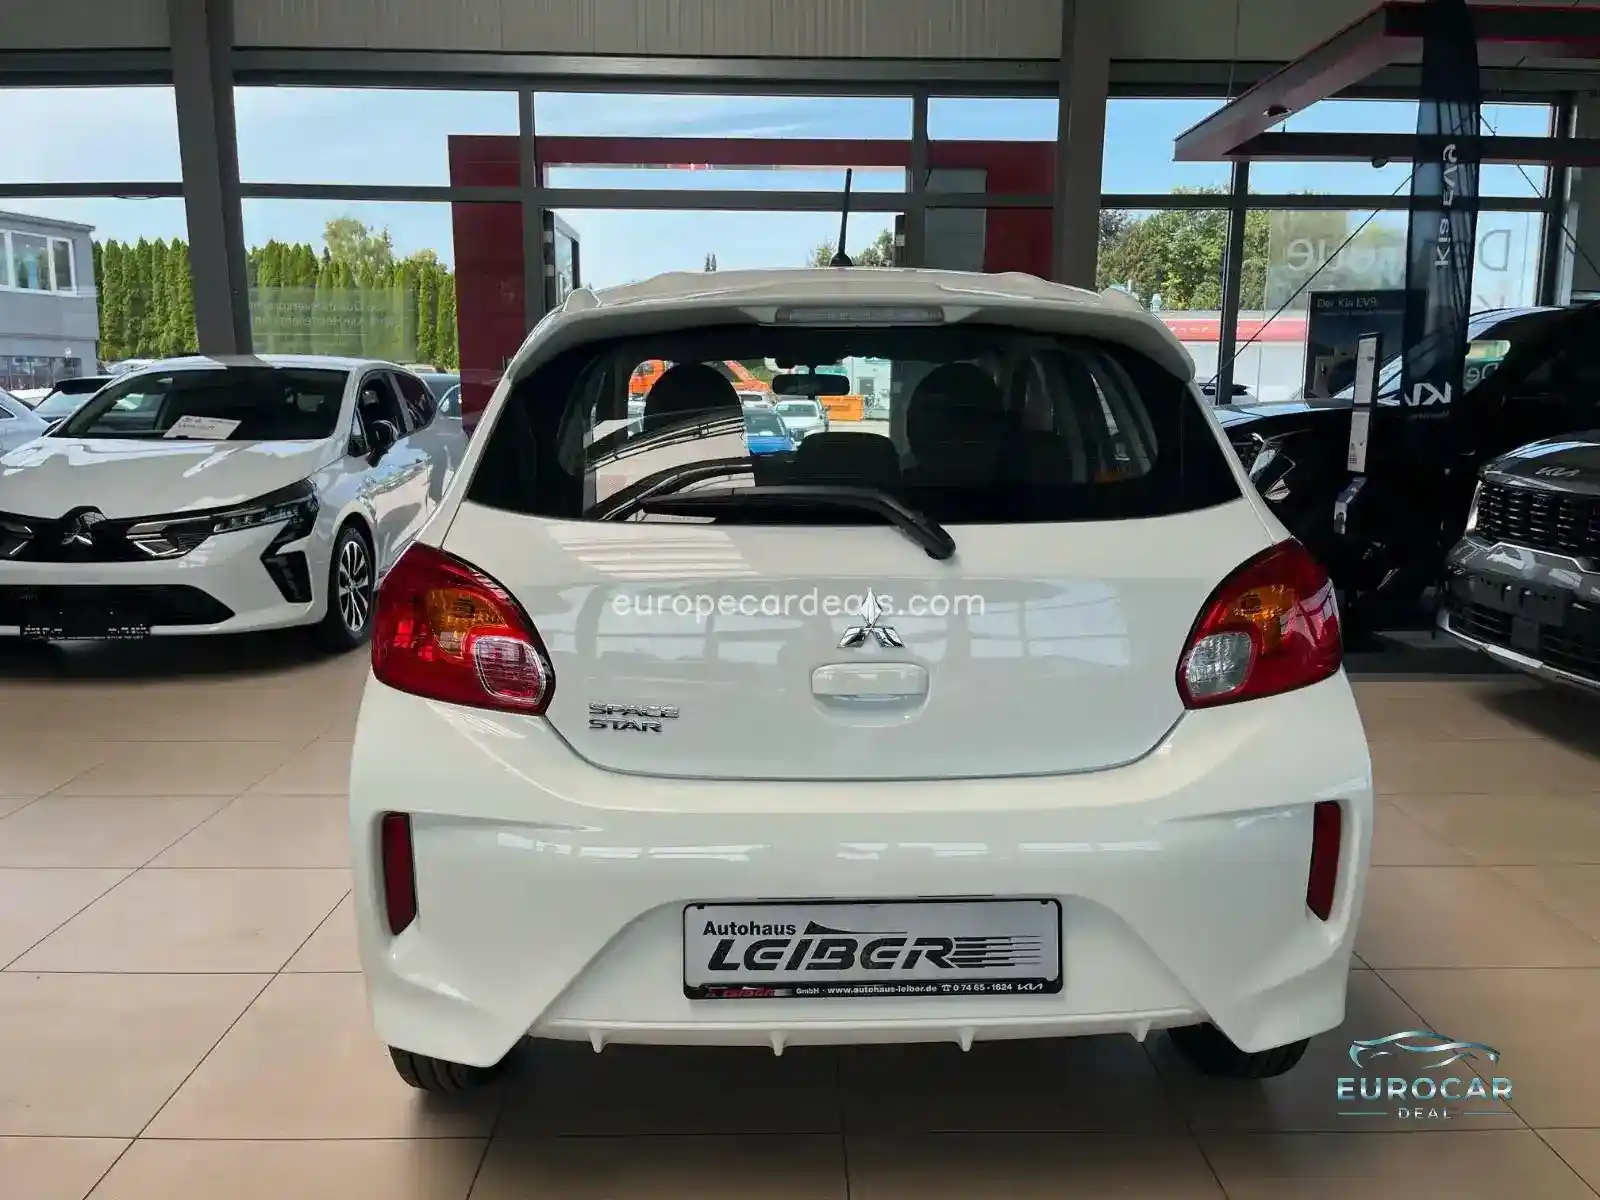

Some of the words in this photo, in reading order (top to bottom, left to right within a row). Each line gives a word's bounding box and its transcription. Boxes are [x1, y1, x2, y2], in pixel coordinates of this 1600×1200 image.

[588, 702, 680, 719] SPACE
[588, 718, 663, 733] STAR
[702, 920, 797, 936] Autohaus
[707, 937, 955, 971] LEIBER
[827, 984, 937, 994] www.autohaus-leiber.de
